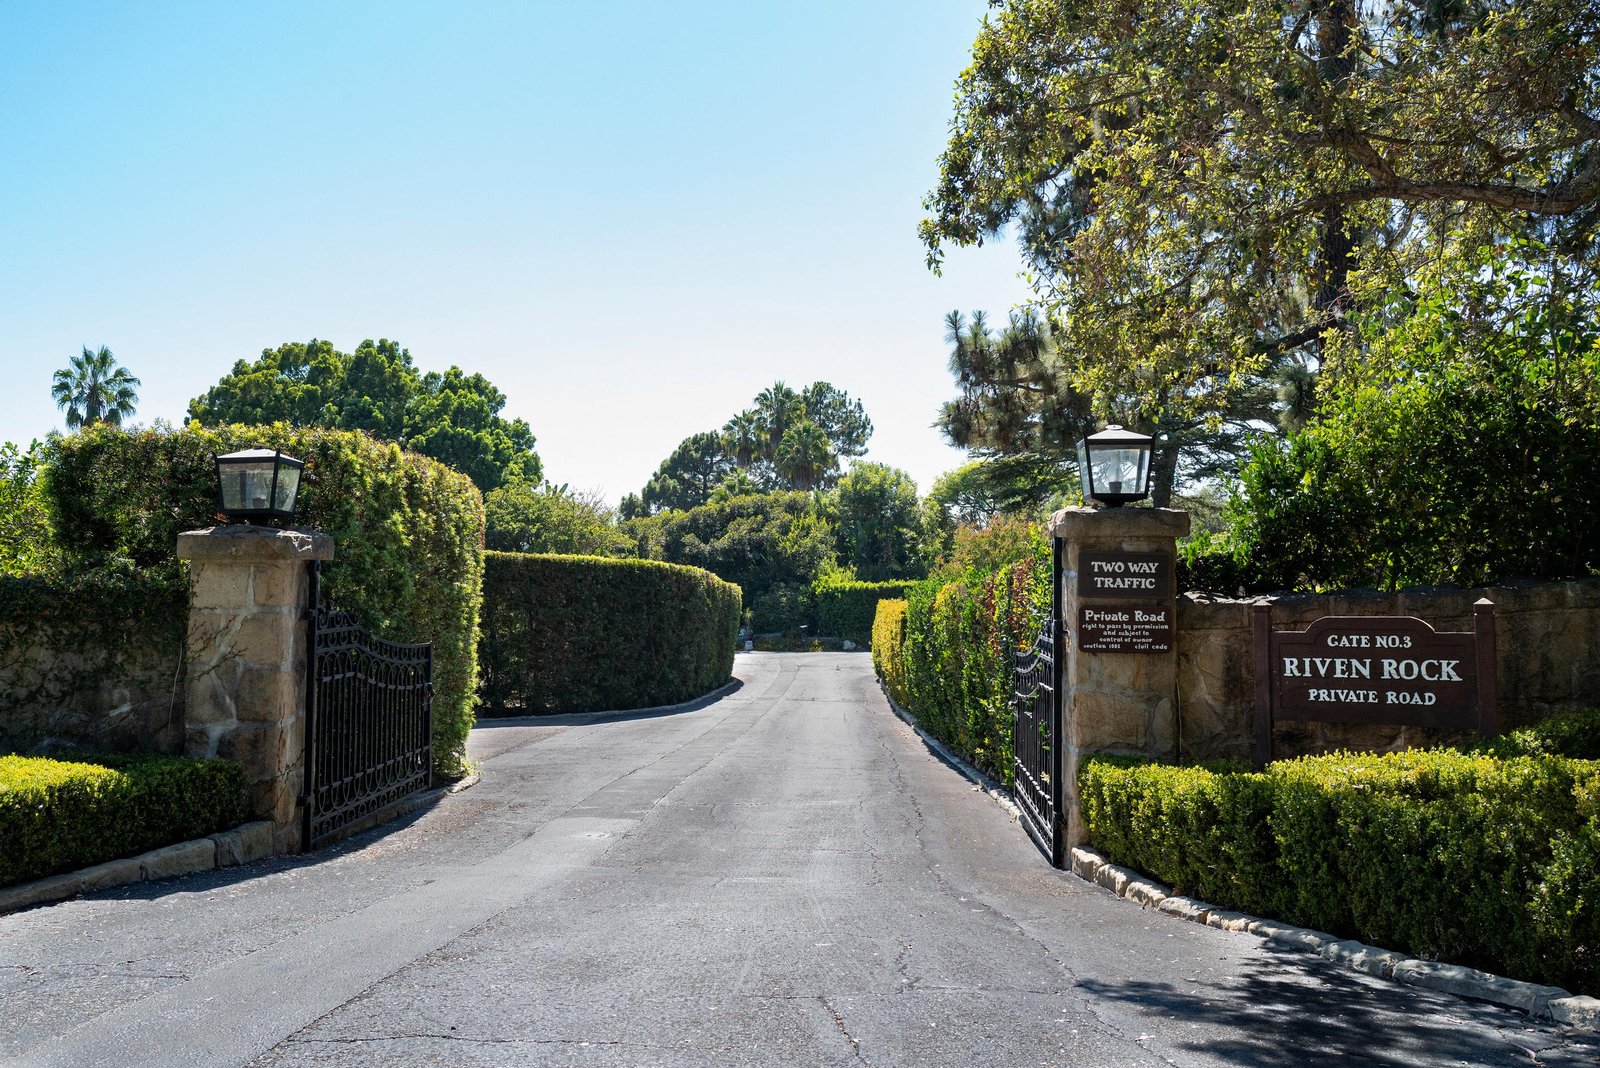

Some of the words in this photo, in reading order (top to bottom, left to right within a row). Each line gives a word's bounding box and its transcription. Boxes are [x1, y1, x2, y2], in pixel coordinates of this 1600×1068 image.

[1091, 562, 1124, 572] TWO
[1128, 562, 1159, 573] WAY
[1094, 577, 1155, 588] TRAFFIC
[1085, 610, 1129, 621] Private
[1134, 610, 1165, 622] Road
[1327, 635, 1370, 648] GATE
[1375, 635, 1412, 648] NO.3
[1283, 657, 1371, 679] RIVEN
[1381, 659, 1462, 681] ROCK
[1308, 689, 1378, 703] PRIVATE
[1386, 691, 1436, 706] ROAD
